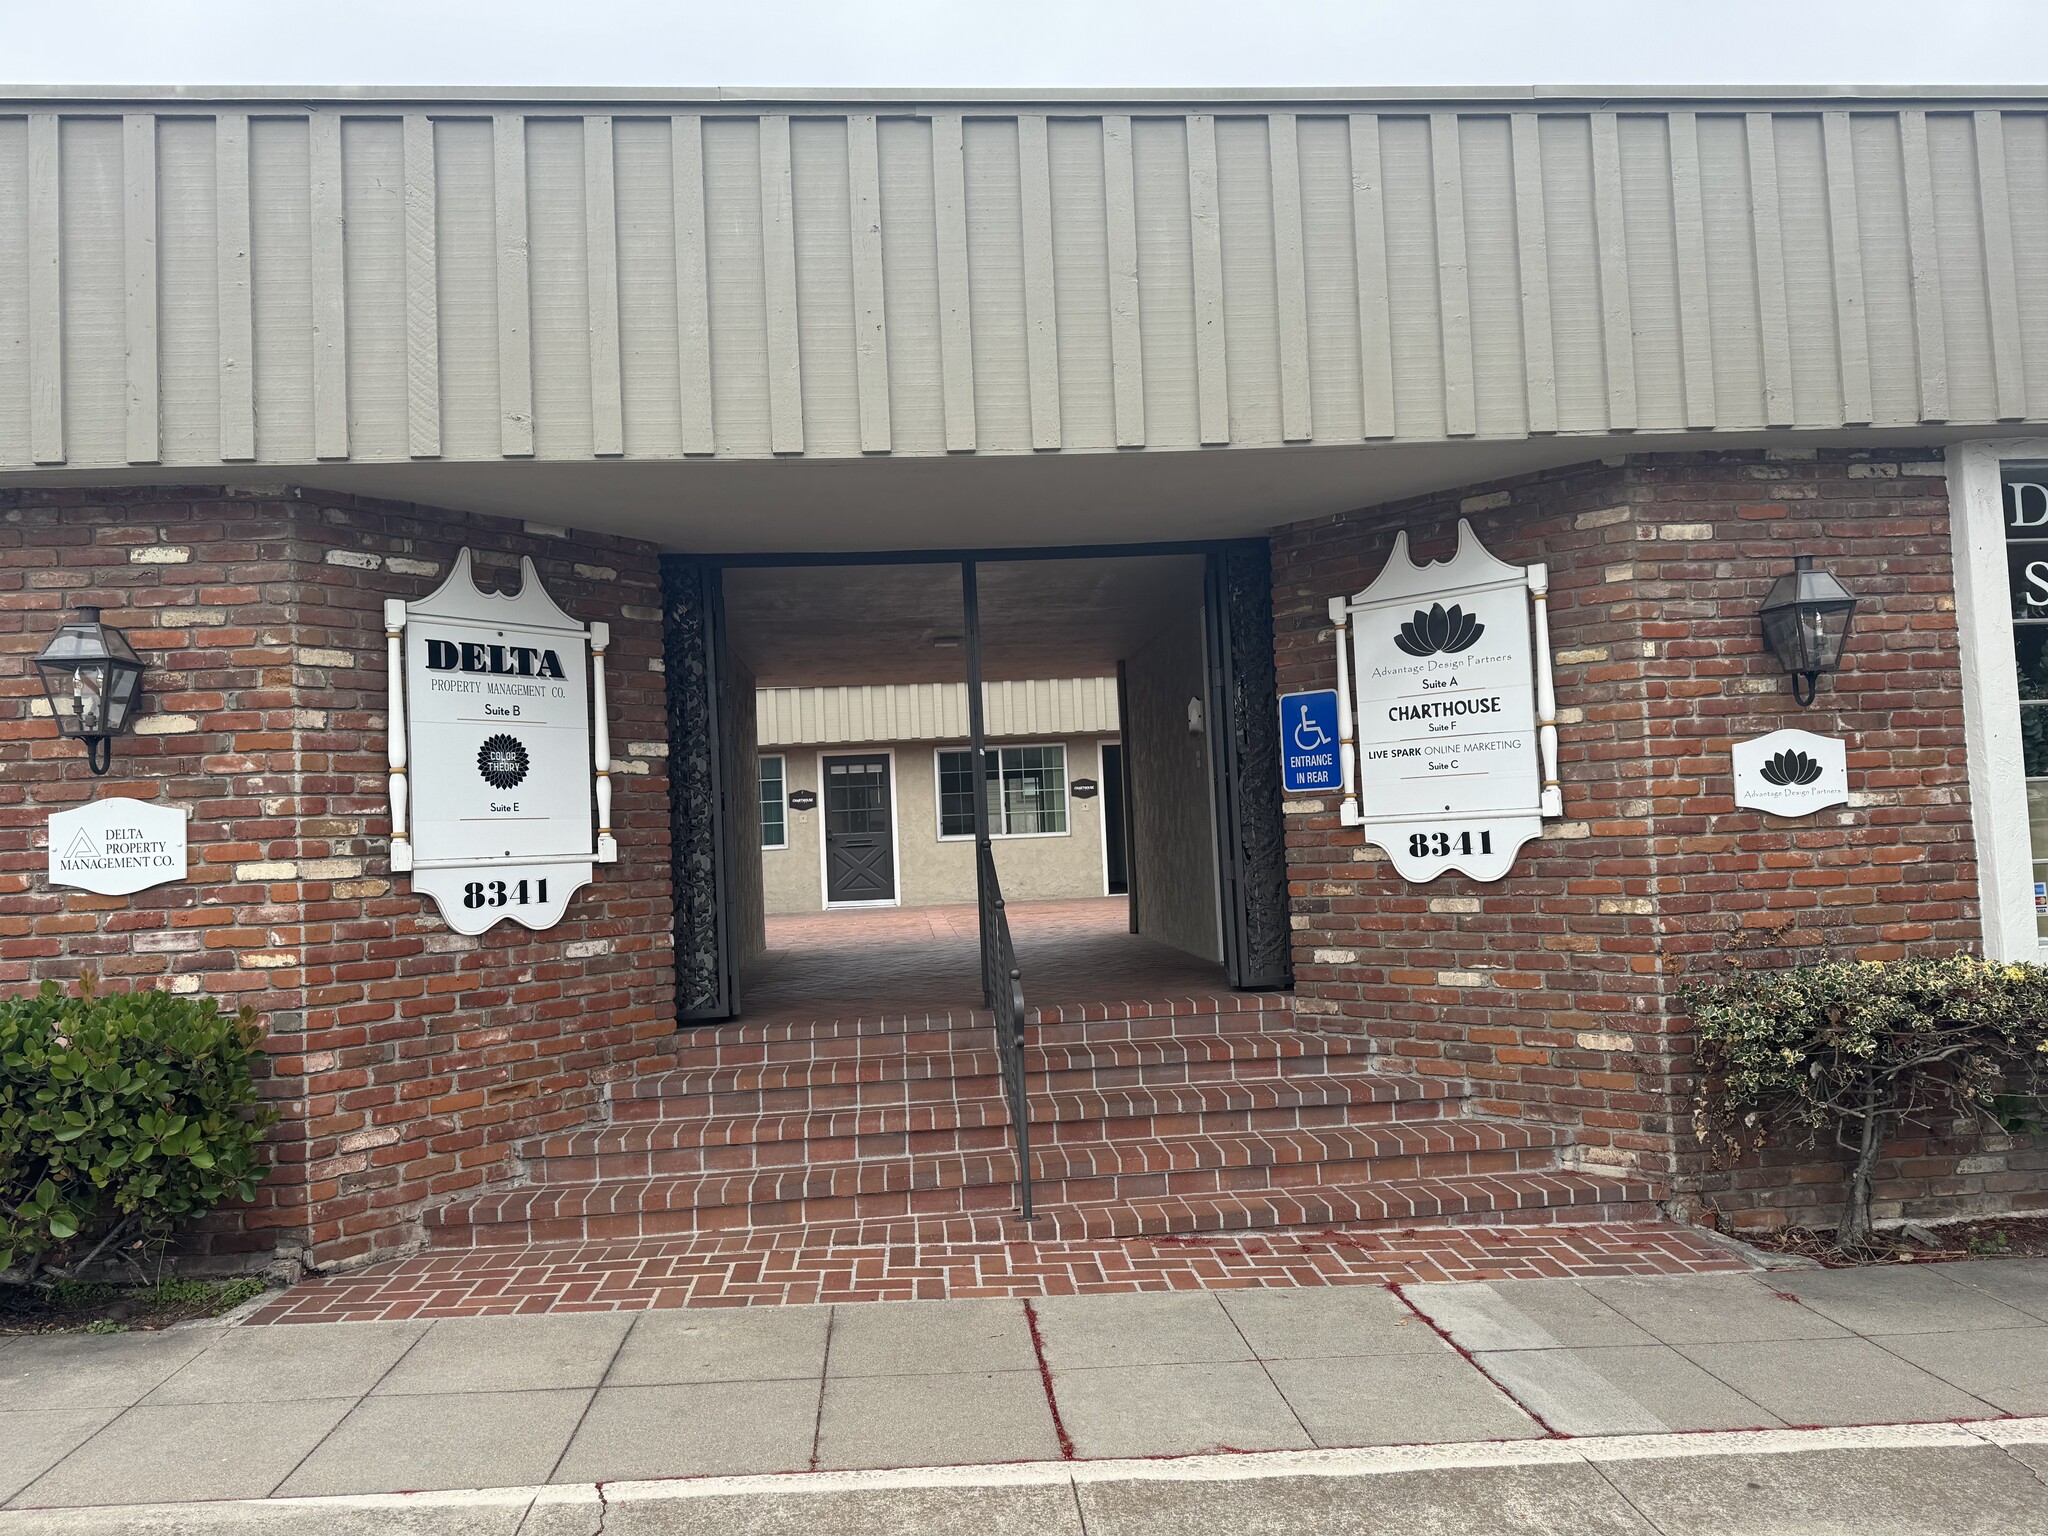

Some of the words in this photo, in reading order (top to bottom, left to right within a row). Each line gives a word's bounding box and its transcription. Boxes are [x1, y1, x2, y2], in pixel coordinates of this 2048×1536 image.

[425, 639, 567, 680] DELTA
[1371, 664, 1425, 679] Advantage
[1427, 659, 1464, 671] Design
[1467, 653, 1512, 667] Partners
[431, 678, 481, 694] PROPERTY
[487, 682, 547, 698] MANAGEMENT
[551, 686, 566, 699] CO.
[1422, 678, 1447, 690] Suite
[1449, 675, 1459, 687] A
[484, 703, 510, 716] Suite
[512, 705, 521, 716] B
[1388, 696, 1501, 722] CHARTHOUSE
[1428, 722, 1449, 733] Suite
[1450, 721, 1457, 731] F
[490, 751, 517, 761] COLOR
[1368, 750, 1389, 760] LIVE
[1391, 747, 1422, 758] SPARK
[1424, 744, 1461, 756] ONLINE
[1463, 739, 1522, 753] MARKETING
[487, 762, 520, 772] THEORY
[1290, 753, 1333, 768] ENTRANCE
[1428, 761, 1449, 771] Suite
[1450, 759, 1459, 769] C
[1296, 772, 1306, 784] IN
[1307, 770, 1329, 783] REAR
[1744, 789, 1783, 799] Advantage
[1784, 788, 1810, 798] Design
[1811, 787, 1842, 796] Partners
[490, 802, 512, 812] Suite
[513, 802, 520, 812] E
[105, 828, 144, 840] DELTA
[106, 841, 166, 855] PROPERTY
[1408, 829, 1494, 858] 8341
[60, 855, 151, 870] MANAGEMENT
[153, 855, 175, 867] CO.
[463, 877, 550, 910] 8341
